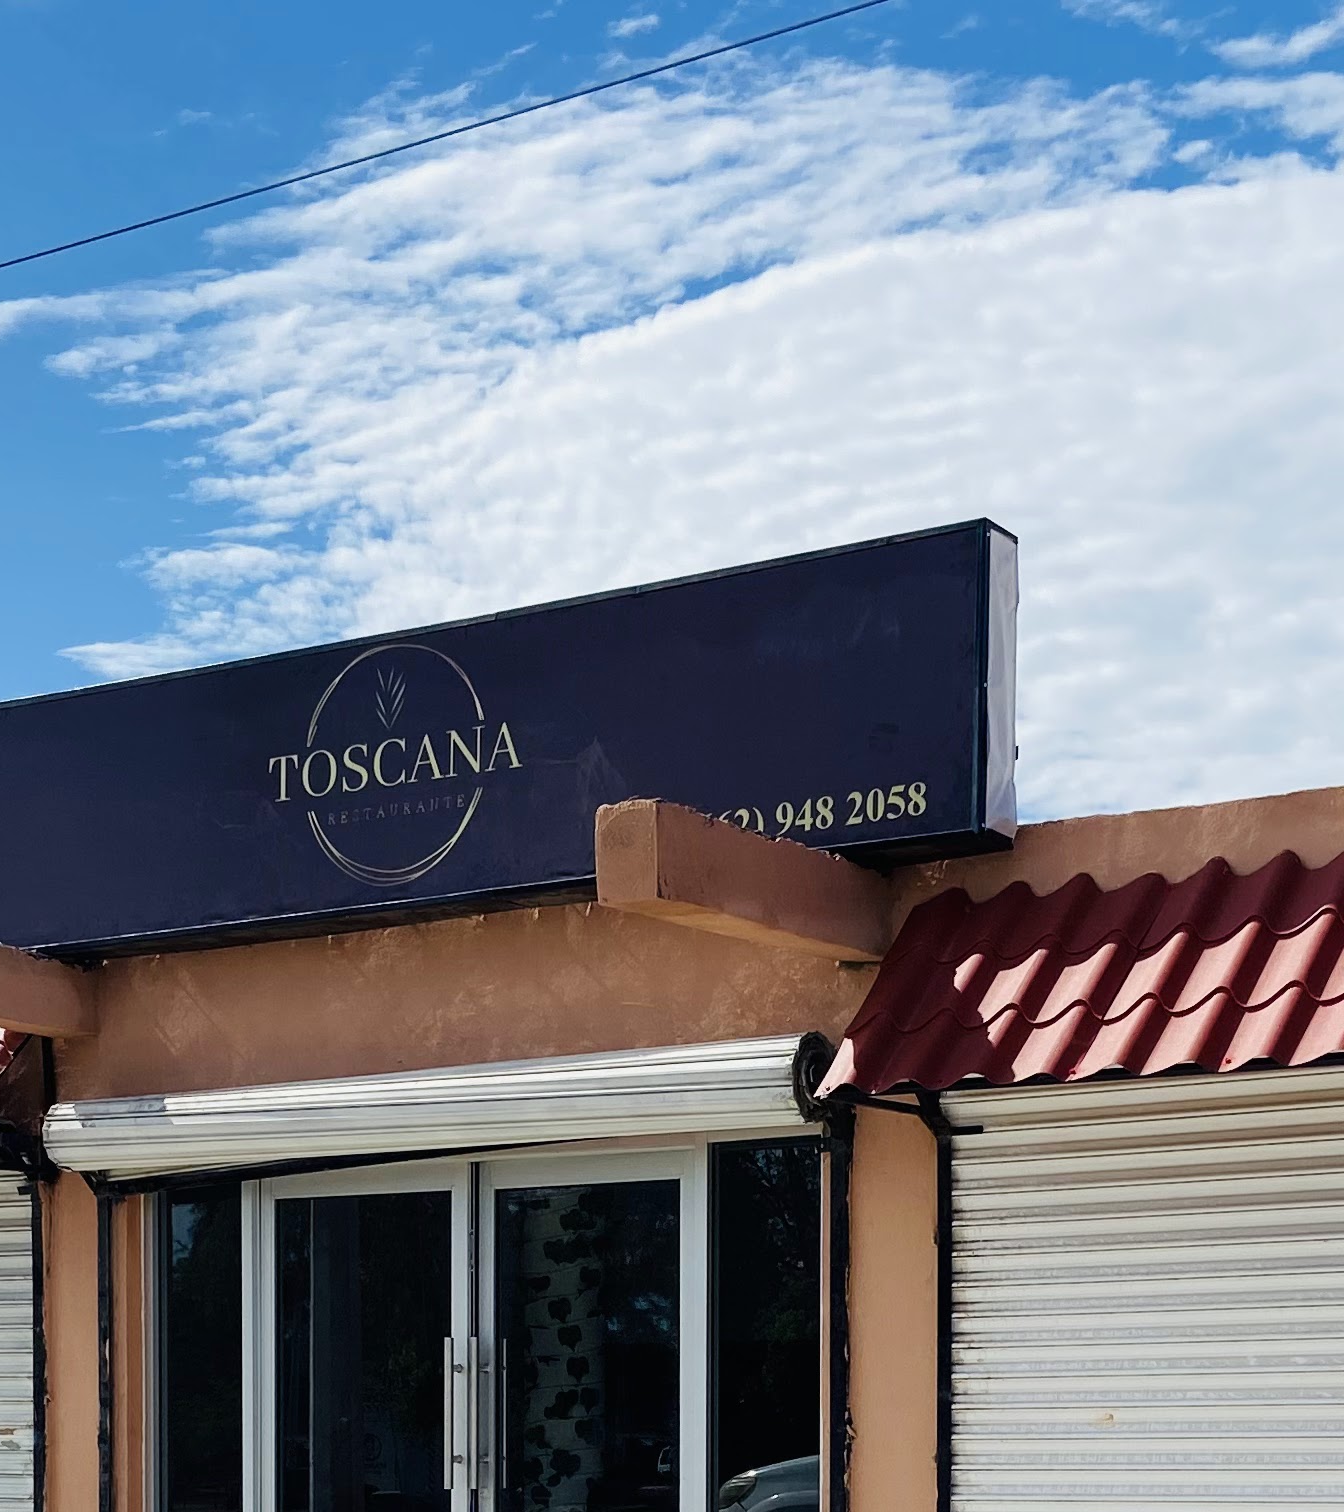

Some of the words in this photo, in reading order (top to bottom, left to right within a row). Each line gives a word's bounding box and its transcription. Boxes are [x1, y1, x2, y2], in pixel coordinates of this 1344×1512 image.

[268, 722, 523, 802] TOSCANA
[775, 796, 834, 836] 948
[845, 782, 927, 826] 2058
